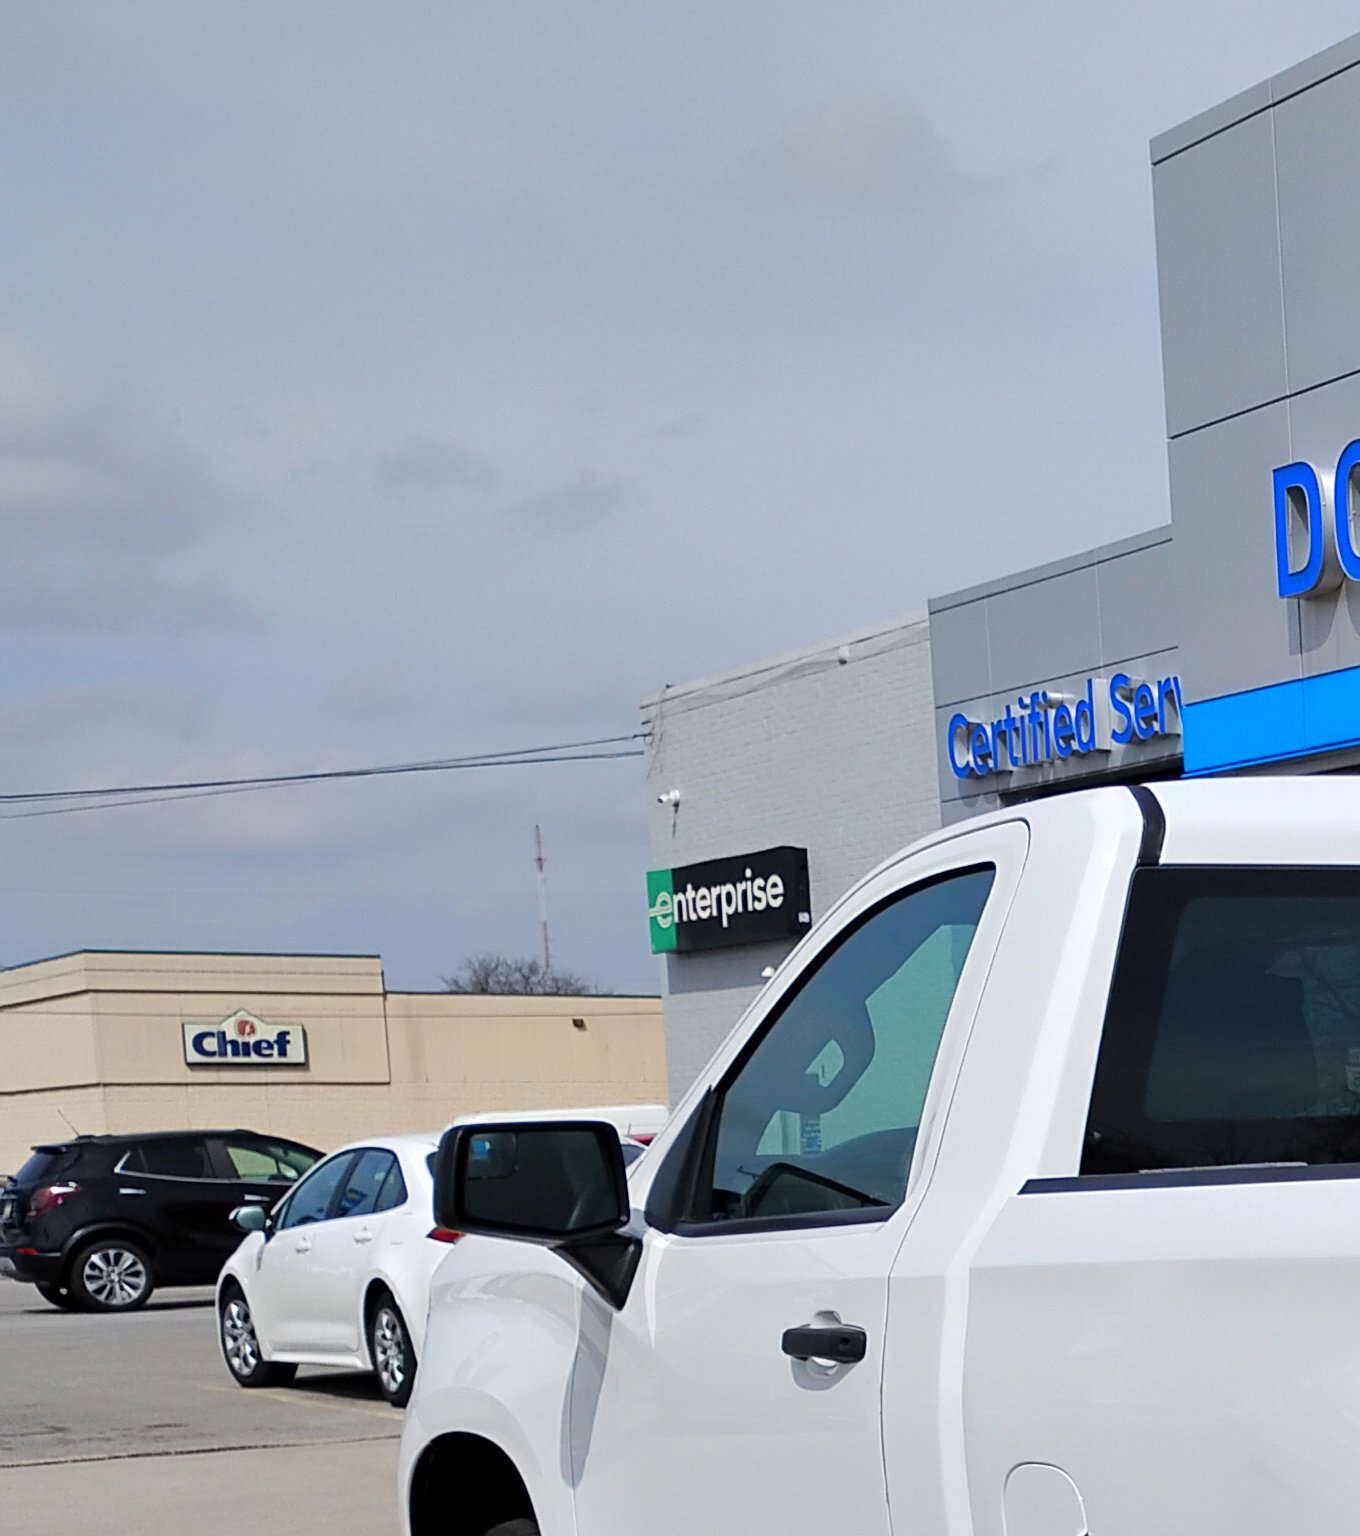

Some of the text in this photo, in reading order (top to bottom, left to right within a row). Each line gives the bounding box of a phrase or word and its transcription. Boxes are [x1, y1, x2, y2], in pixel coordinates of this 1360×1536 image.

[948, 677, 1100, 779] Certified
[649, 866, 785, 929] enterprise
[192, 1030, 291, 1058] Chief
